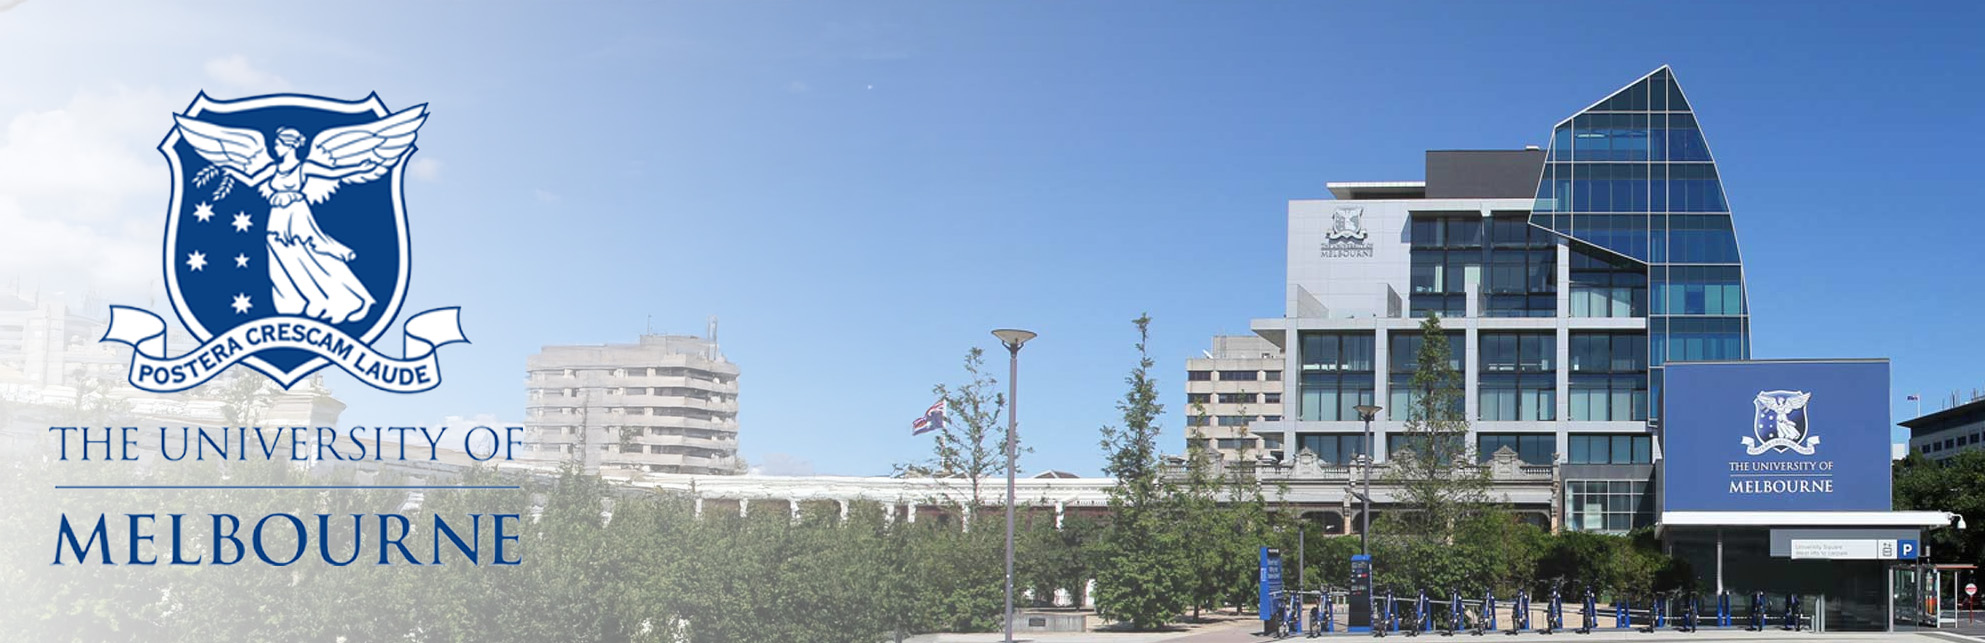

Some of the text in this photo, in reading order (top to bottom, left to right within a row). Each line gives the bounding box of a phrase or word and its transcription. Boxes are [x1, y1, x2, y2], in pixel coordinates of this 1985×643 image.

[1729, 461, 1833, 471] THE UNIVERSITY OF
[1729, 480, 1834, 493] MELBOURNE
[1902, 543, 1913, 556] P
